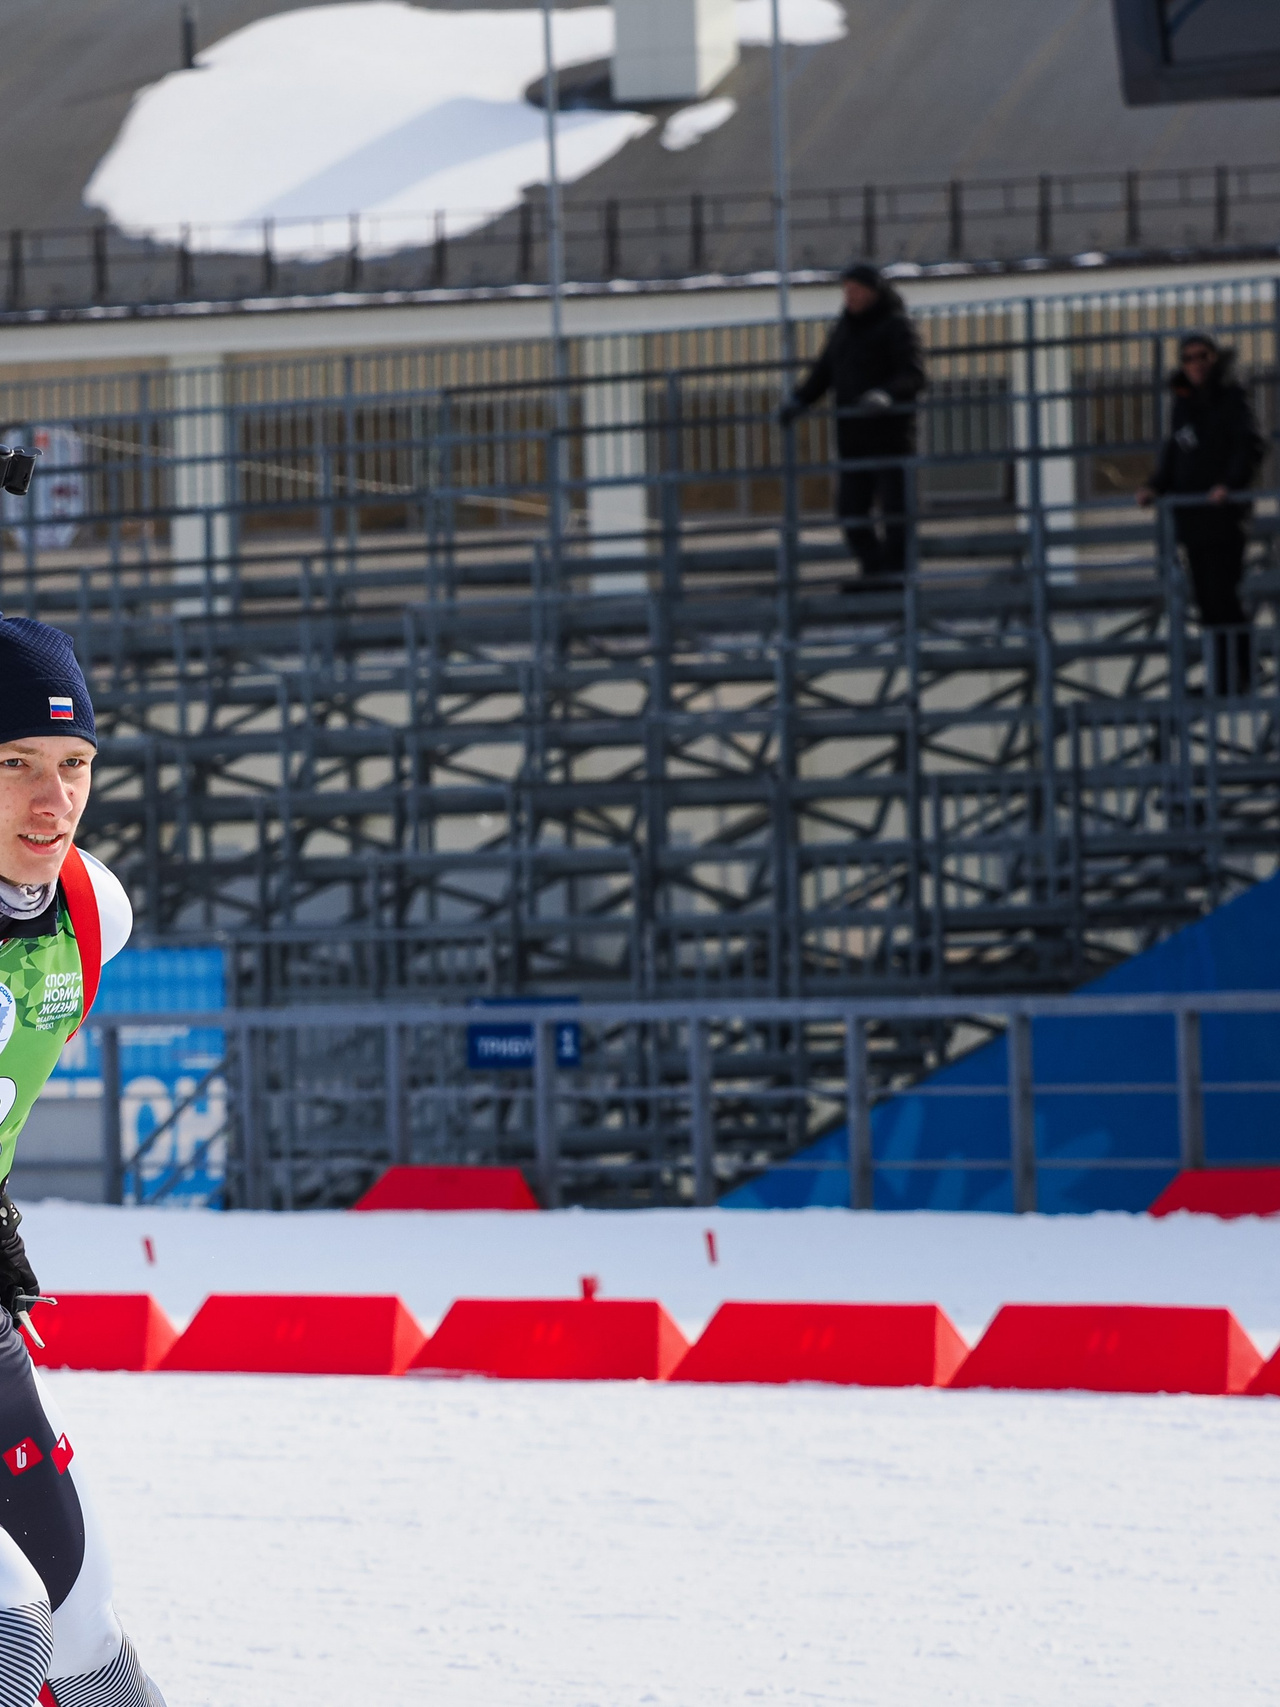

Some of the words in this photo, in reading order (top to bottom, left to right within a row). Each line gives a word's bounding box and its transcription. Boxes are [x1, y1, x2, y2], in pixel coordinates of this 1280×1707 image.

[43, 985, 81, 1003] НОРМА
[38, 1000, 79, 1016] ЖИЗНИ
[35, 1022, 54, 1032] ПРОЕКТ
